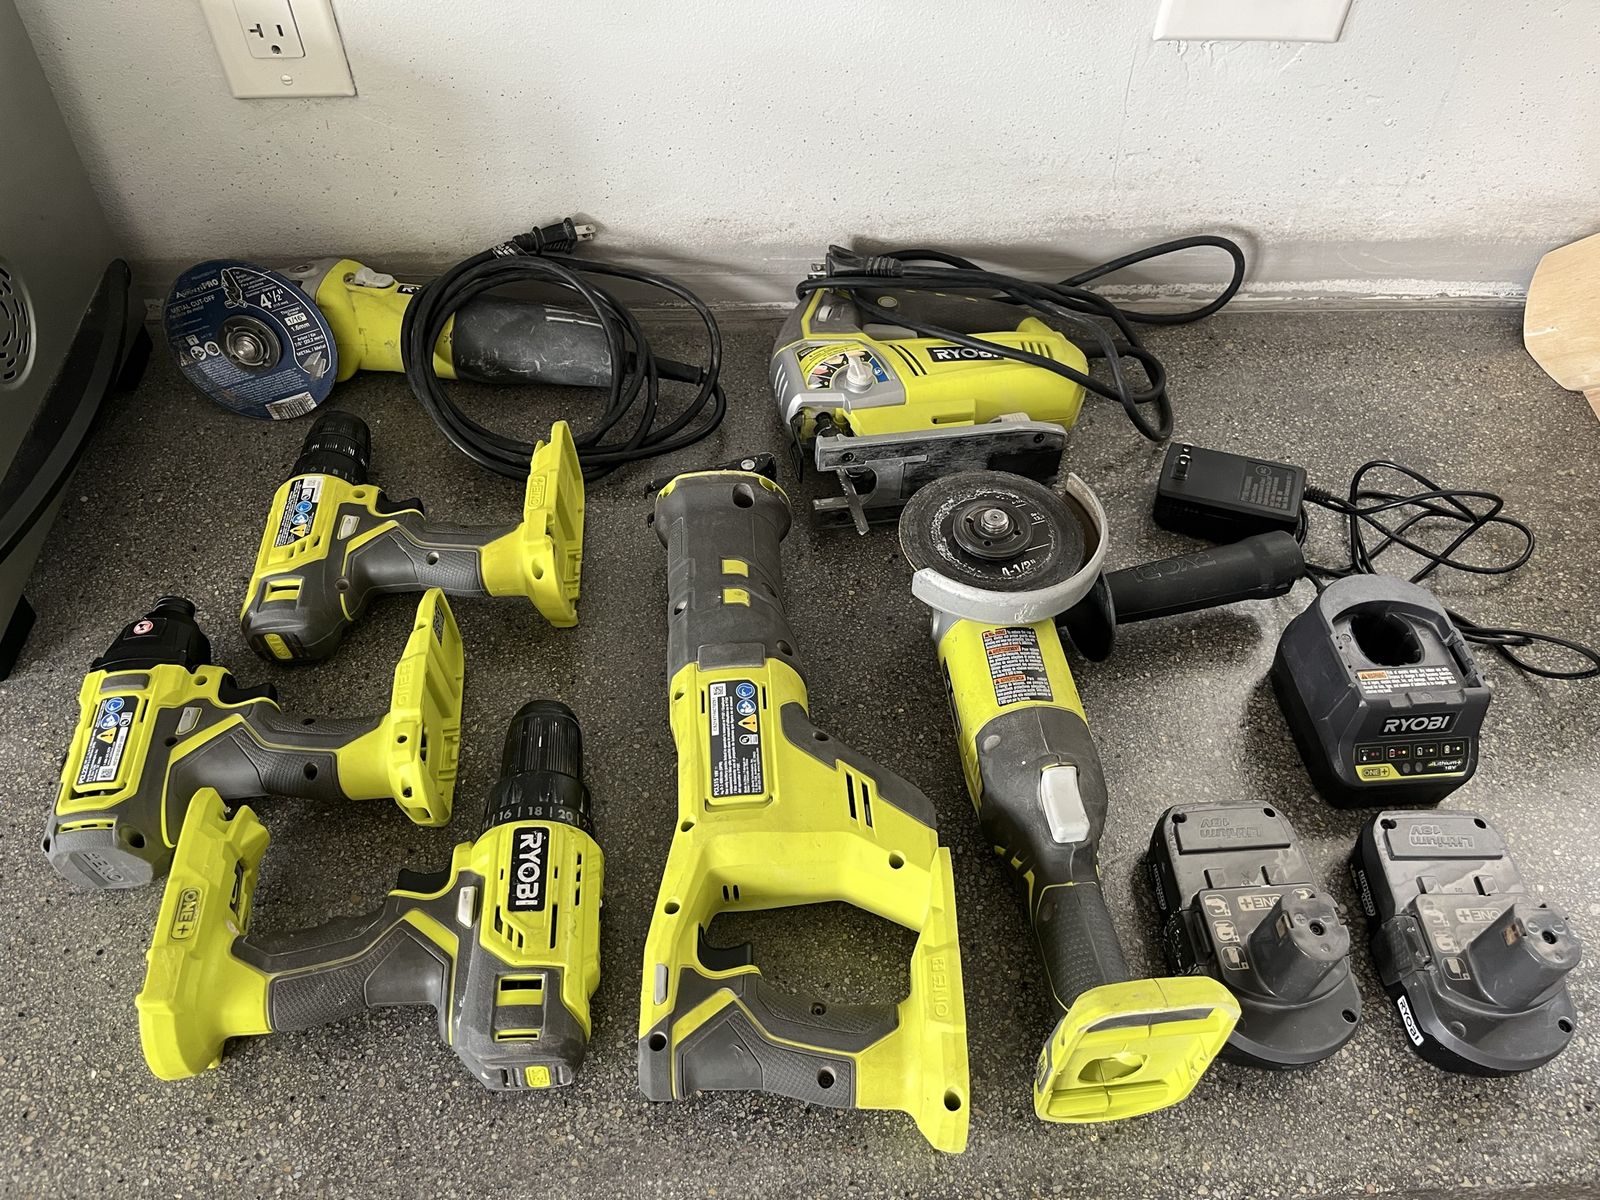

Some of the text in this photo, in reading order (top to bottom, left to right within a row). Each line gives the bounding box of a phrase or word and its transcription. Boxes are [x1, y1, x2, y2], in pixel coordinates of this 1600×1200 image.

[190, 294, 216, 307] CUT-OFF
[1383, 715, 1450, 733] RYOBI
[1363, 767, 1389, 777] ONE+
[499, 809, 512, 821] 16
[528, 806, 543, 816] 18
[558, 809, 573, 821] 20
[1200, 816, 1231, 829] 18V
[1409, 823, 1441, 836] 18V
[1200, 826, 1263, 839] Lithium
[1409, 834, 1475, 848] Lithium
[515, 833, 542, 906] RYOBI
[1239, 893, 1281, 910] ONE+
[178, 890, 197, 935] ONE+
[1456, 907, 1501, 924] ONE+
[1398, 999, 1421, 1044] RYOBI
